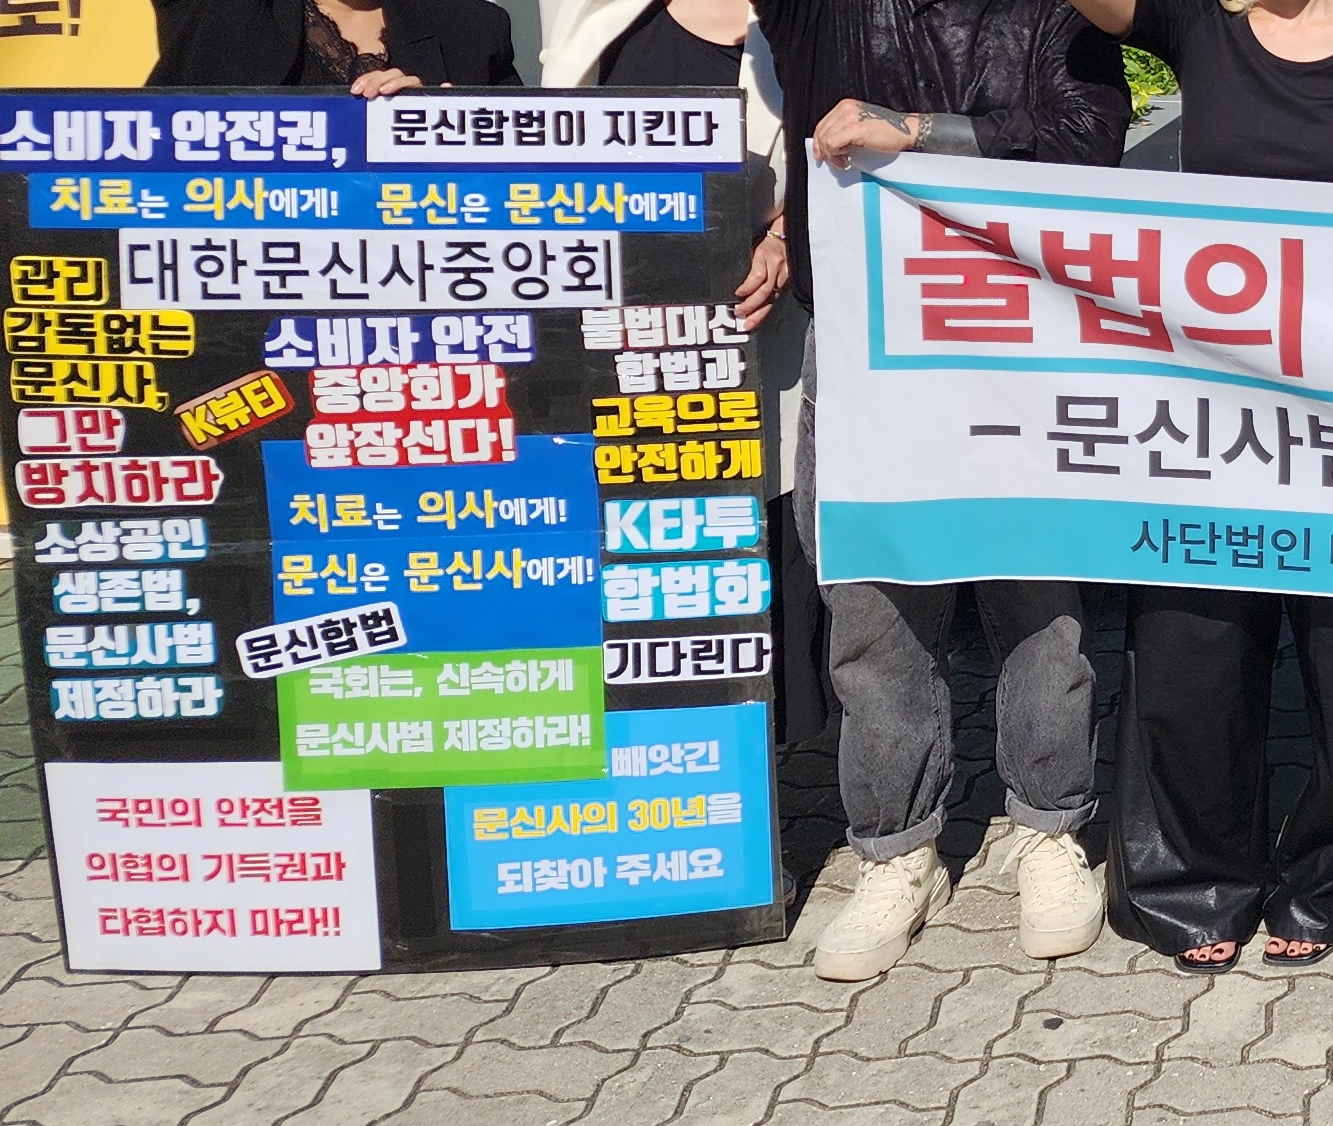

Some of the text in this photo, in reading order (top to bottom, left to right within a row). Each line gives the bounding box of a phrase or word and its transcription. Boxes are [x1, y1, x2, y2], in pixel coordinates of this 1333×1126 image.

[0, 110, 347, 168] 소비자 안전권,
[391, 107, 719, 148] 문신합법이 지킨다
[51, 177, 697, 224] 치료는 의사에게! 문신은 문신사에게!
[12, 259, 107, 303] 관리
[128, 238, 616, 304] 대한문신사중앙회
[903, 205, 1304, 379] 불법의
[6, 312, 193, 356] 감독없는
[265, 315, 533, 368] 소비자 안전
[581, 307, 747, 350] 불법대신
[12, 361, 168, 409] 문신사,
[311, 366, 504, 412] 중앙회가
[615, 351, 745, 393] 합법과
[20, 410, 122, 453] 그만
[187, 377, 286, 445] K뷰티
[593, 393, 761, 437] 교육으로
[306, 418, 514, 467] 앞장선다!
[595, 439, 762, 485] 안전하게
[20, 460, 219, 505] 방치하라
[289, 490, 567, 533] 치료는 의사에게!
[606, 499, 758, 549] K타투
[34, 520, 206, 564] 소상공인
[1131, 519, 1312, 571] 사단법인
[53, 570, 199, 615] 생존법,
[278, 548, 594, 595] 문신은 문신사에게!
[604, 562, 770, 616] 합법화
[45, 623, 214, 668] 문신사법
[246, 607, 400, 670] 문신합법
[608, 637, 770, 681] 기다린다
[53, 678, 222, 722] 제정하라
[309, 658, 572, 698] 국회는, 신속하게
[295, 715, 589, 757] 문신사법 제정하라!
[612, 745, 720, 776] 빼앗긴
[96, 795, 323, 828] 국민의 안전을
[473, 792, 742, 842] 문신사의 30년을
[86, 852, 345, 885] 의협의 기득권과
[498, 850, 723, 892] 되찾아 주세요
[99, 907, 341, 938] 타협하지 마라!!
